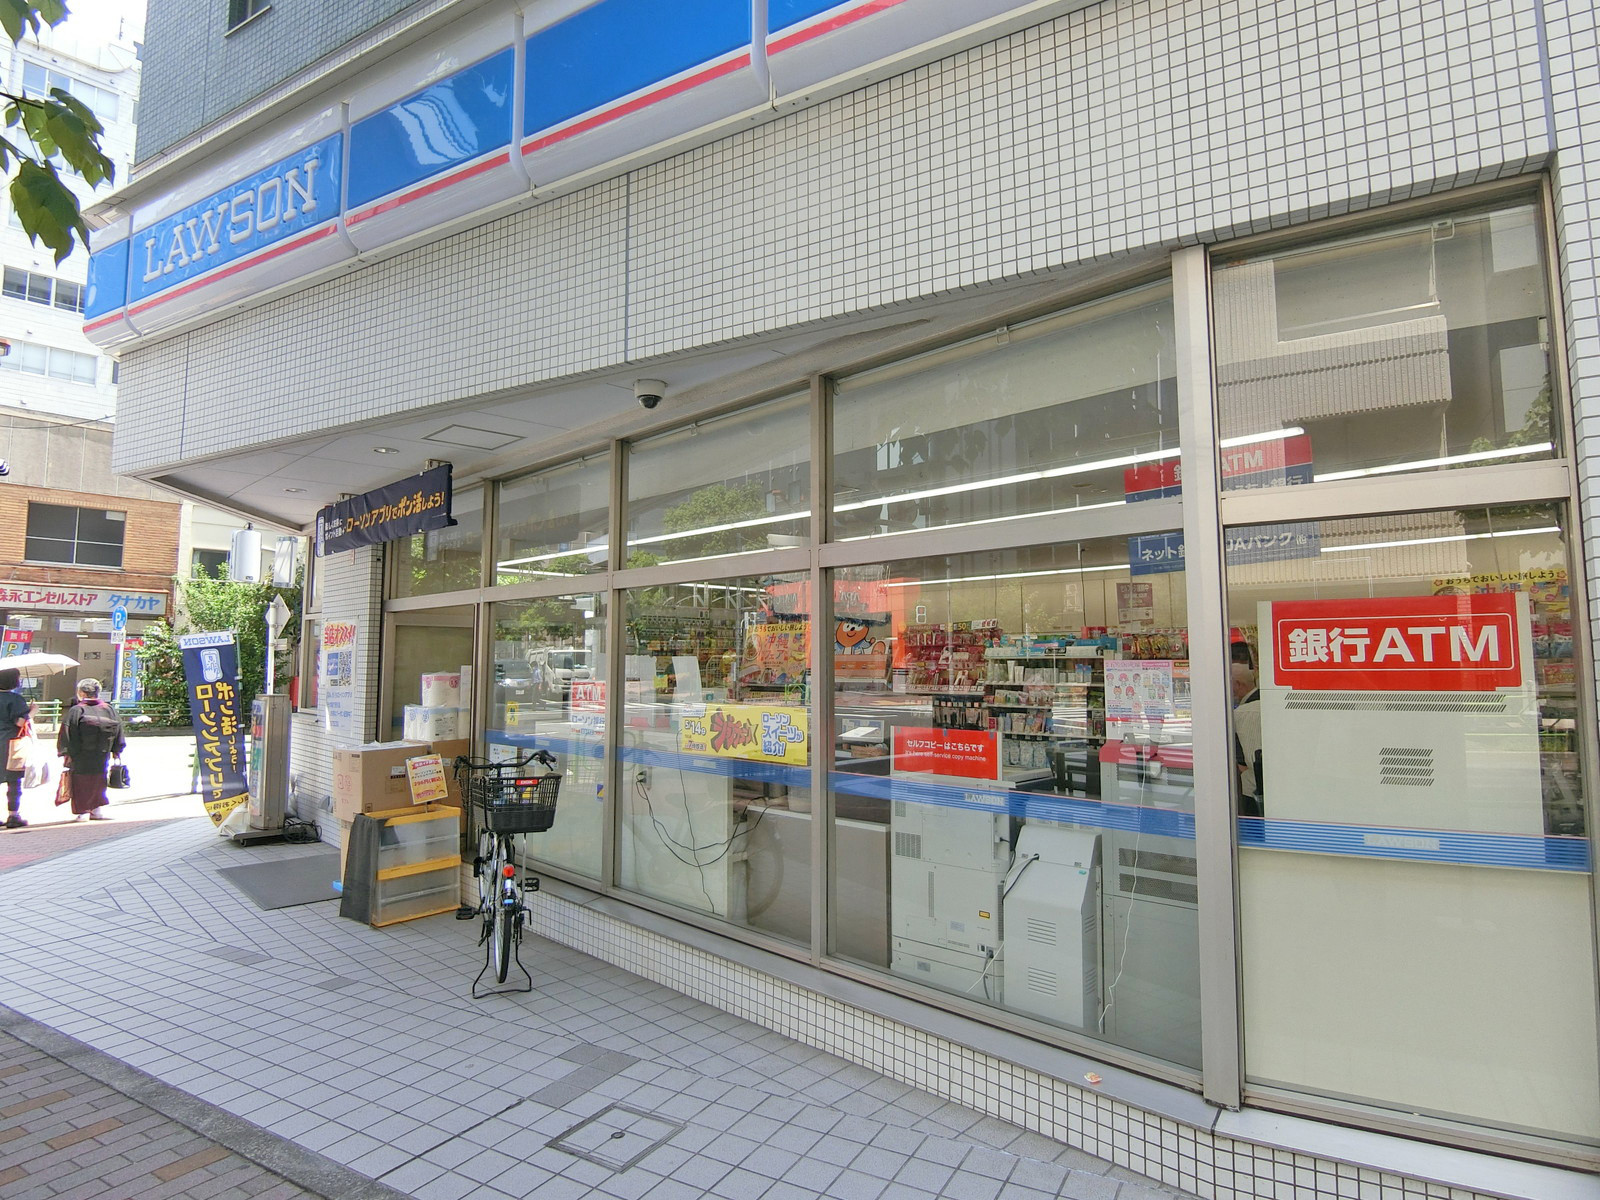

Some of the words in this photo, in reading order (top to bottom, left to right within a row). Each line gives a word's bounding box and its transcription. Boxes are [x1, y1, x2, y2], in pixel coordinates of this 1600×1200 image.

[143, 158, 320, 283] LAWSON
[1446, 570, 1555, 585] おうちでおいしい旅しよう
[107, 594, 161, 611] タナカヤ
[1287, 625, 1500, 663] 銀行ATM
[576, 685, 601, 701] ATM
[762, 713, 790, 724] ローソン
[762, 725, 803, 740] スイーツが
[763, 740, 785, 756] 紹介!
[906, 739, 985, 753] セルフコピーはこちらです
